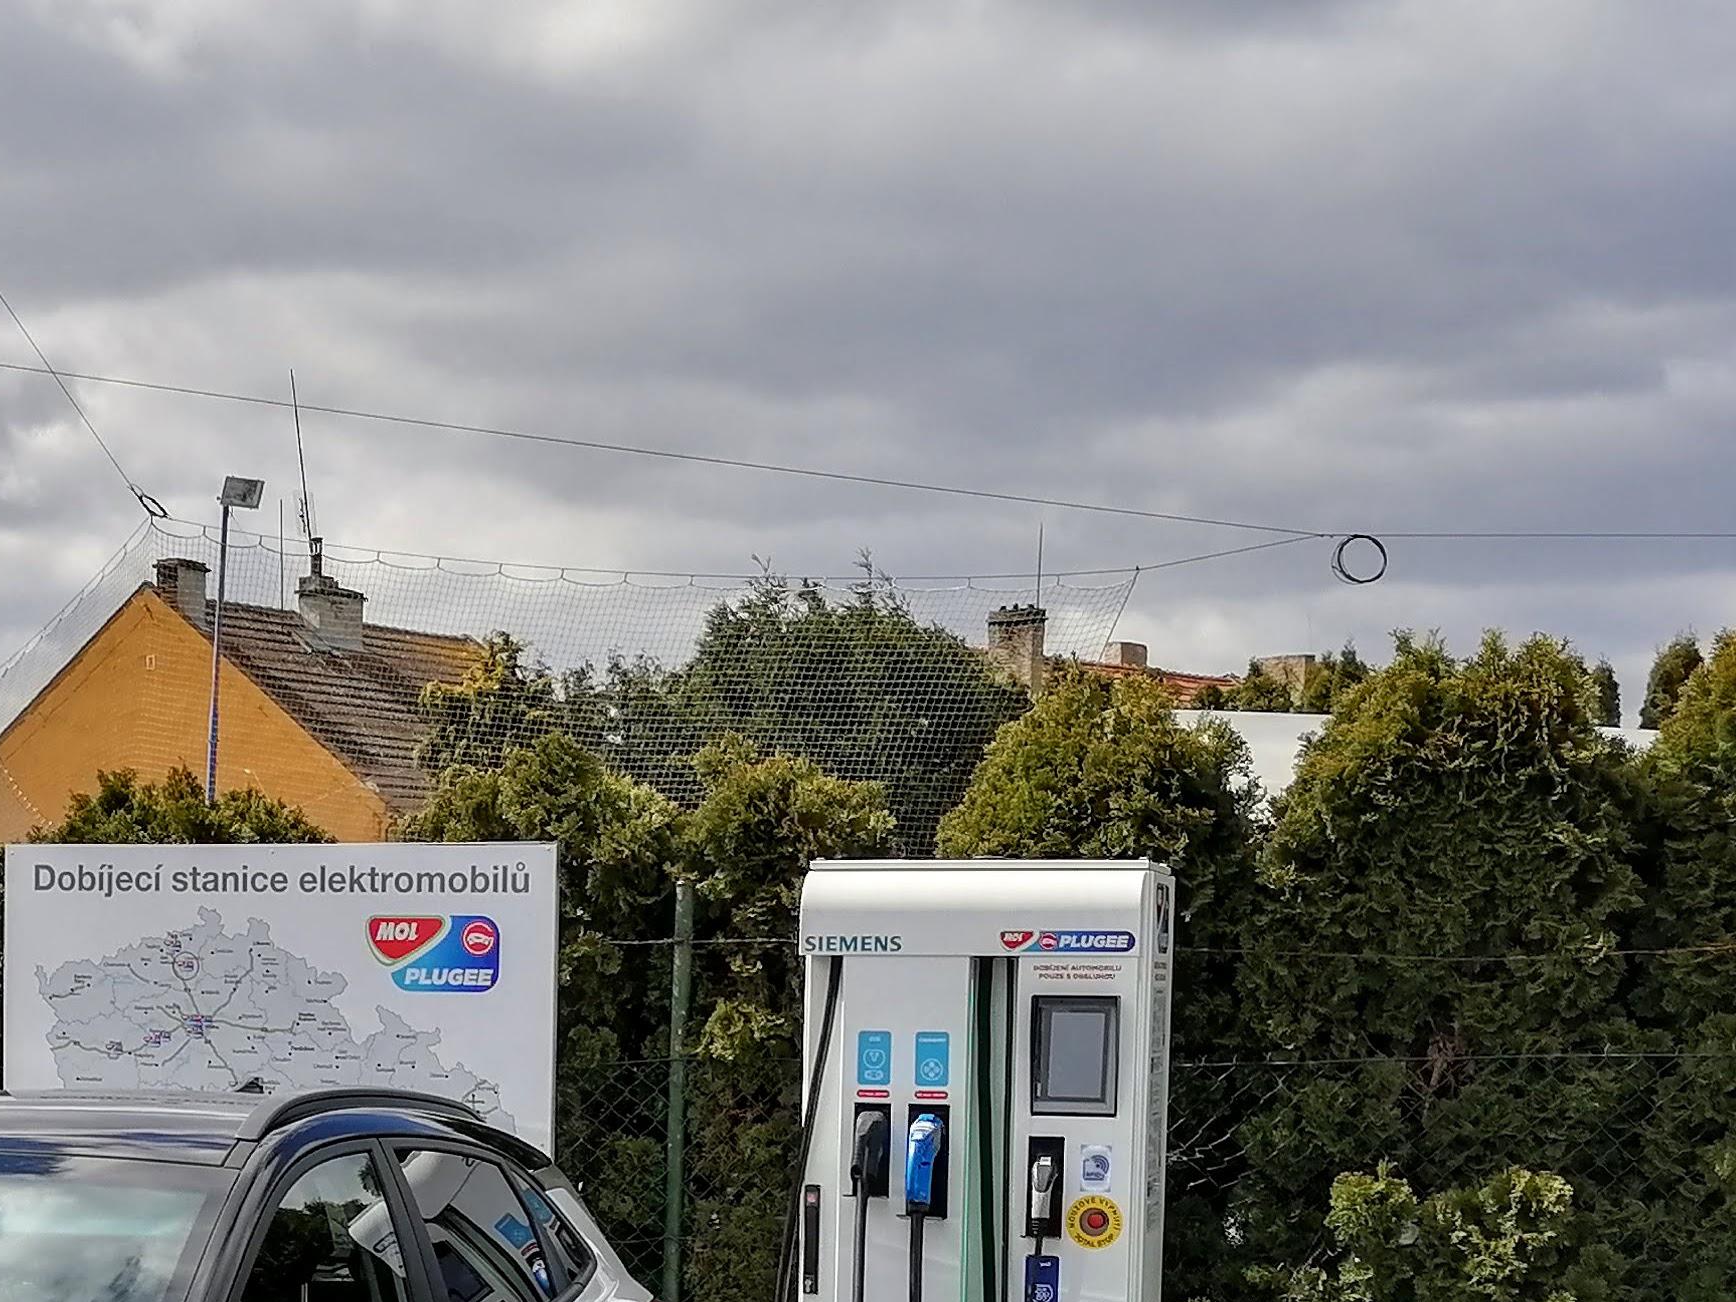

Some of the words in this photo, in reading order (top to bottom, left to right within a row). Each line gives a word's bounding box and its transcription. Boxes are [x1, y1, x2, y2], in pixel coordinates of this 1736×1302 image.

[32, 862, 163, 898] Dobíjecí
[171, 865, 288, 894] stanice
[298, 861, 531, 894] elektromobilů
[375, 920, 419, 943] MOL
[1058, 935, 1130, 948] PLUGEE
[804, 936, 902, 953] SIEMENS
[403, 967, 494, 988] PLUGEE
